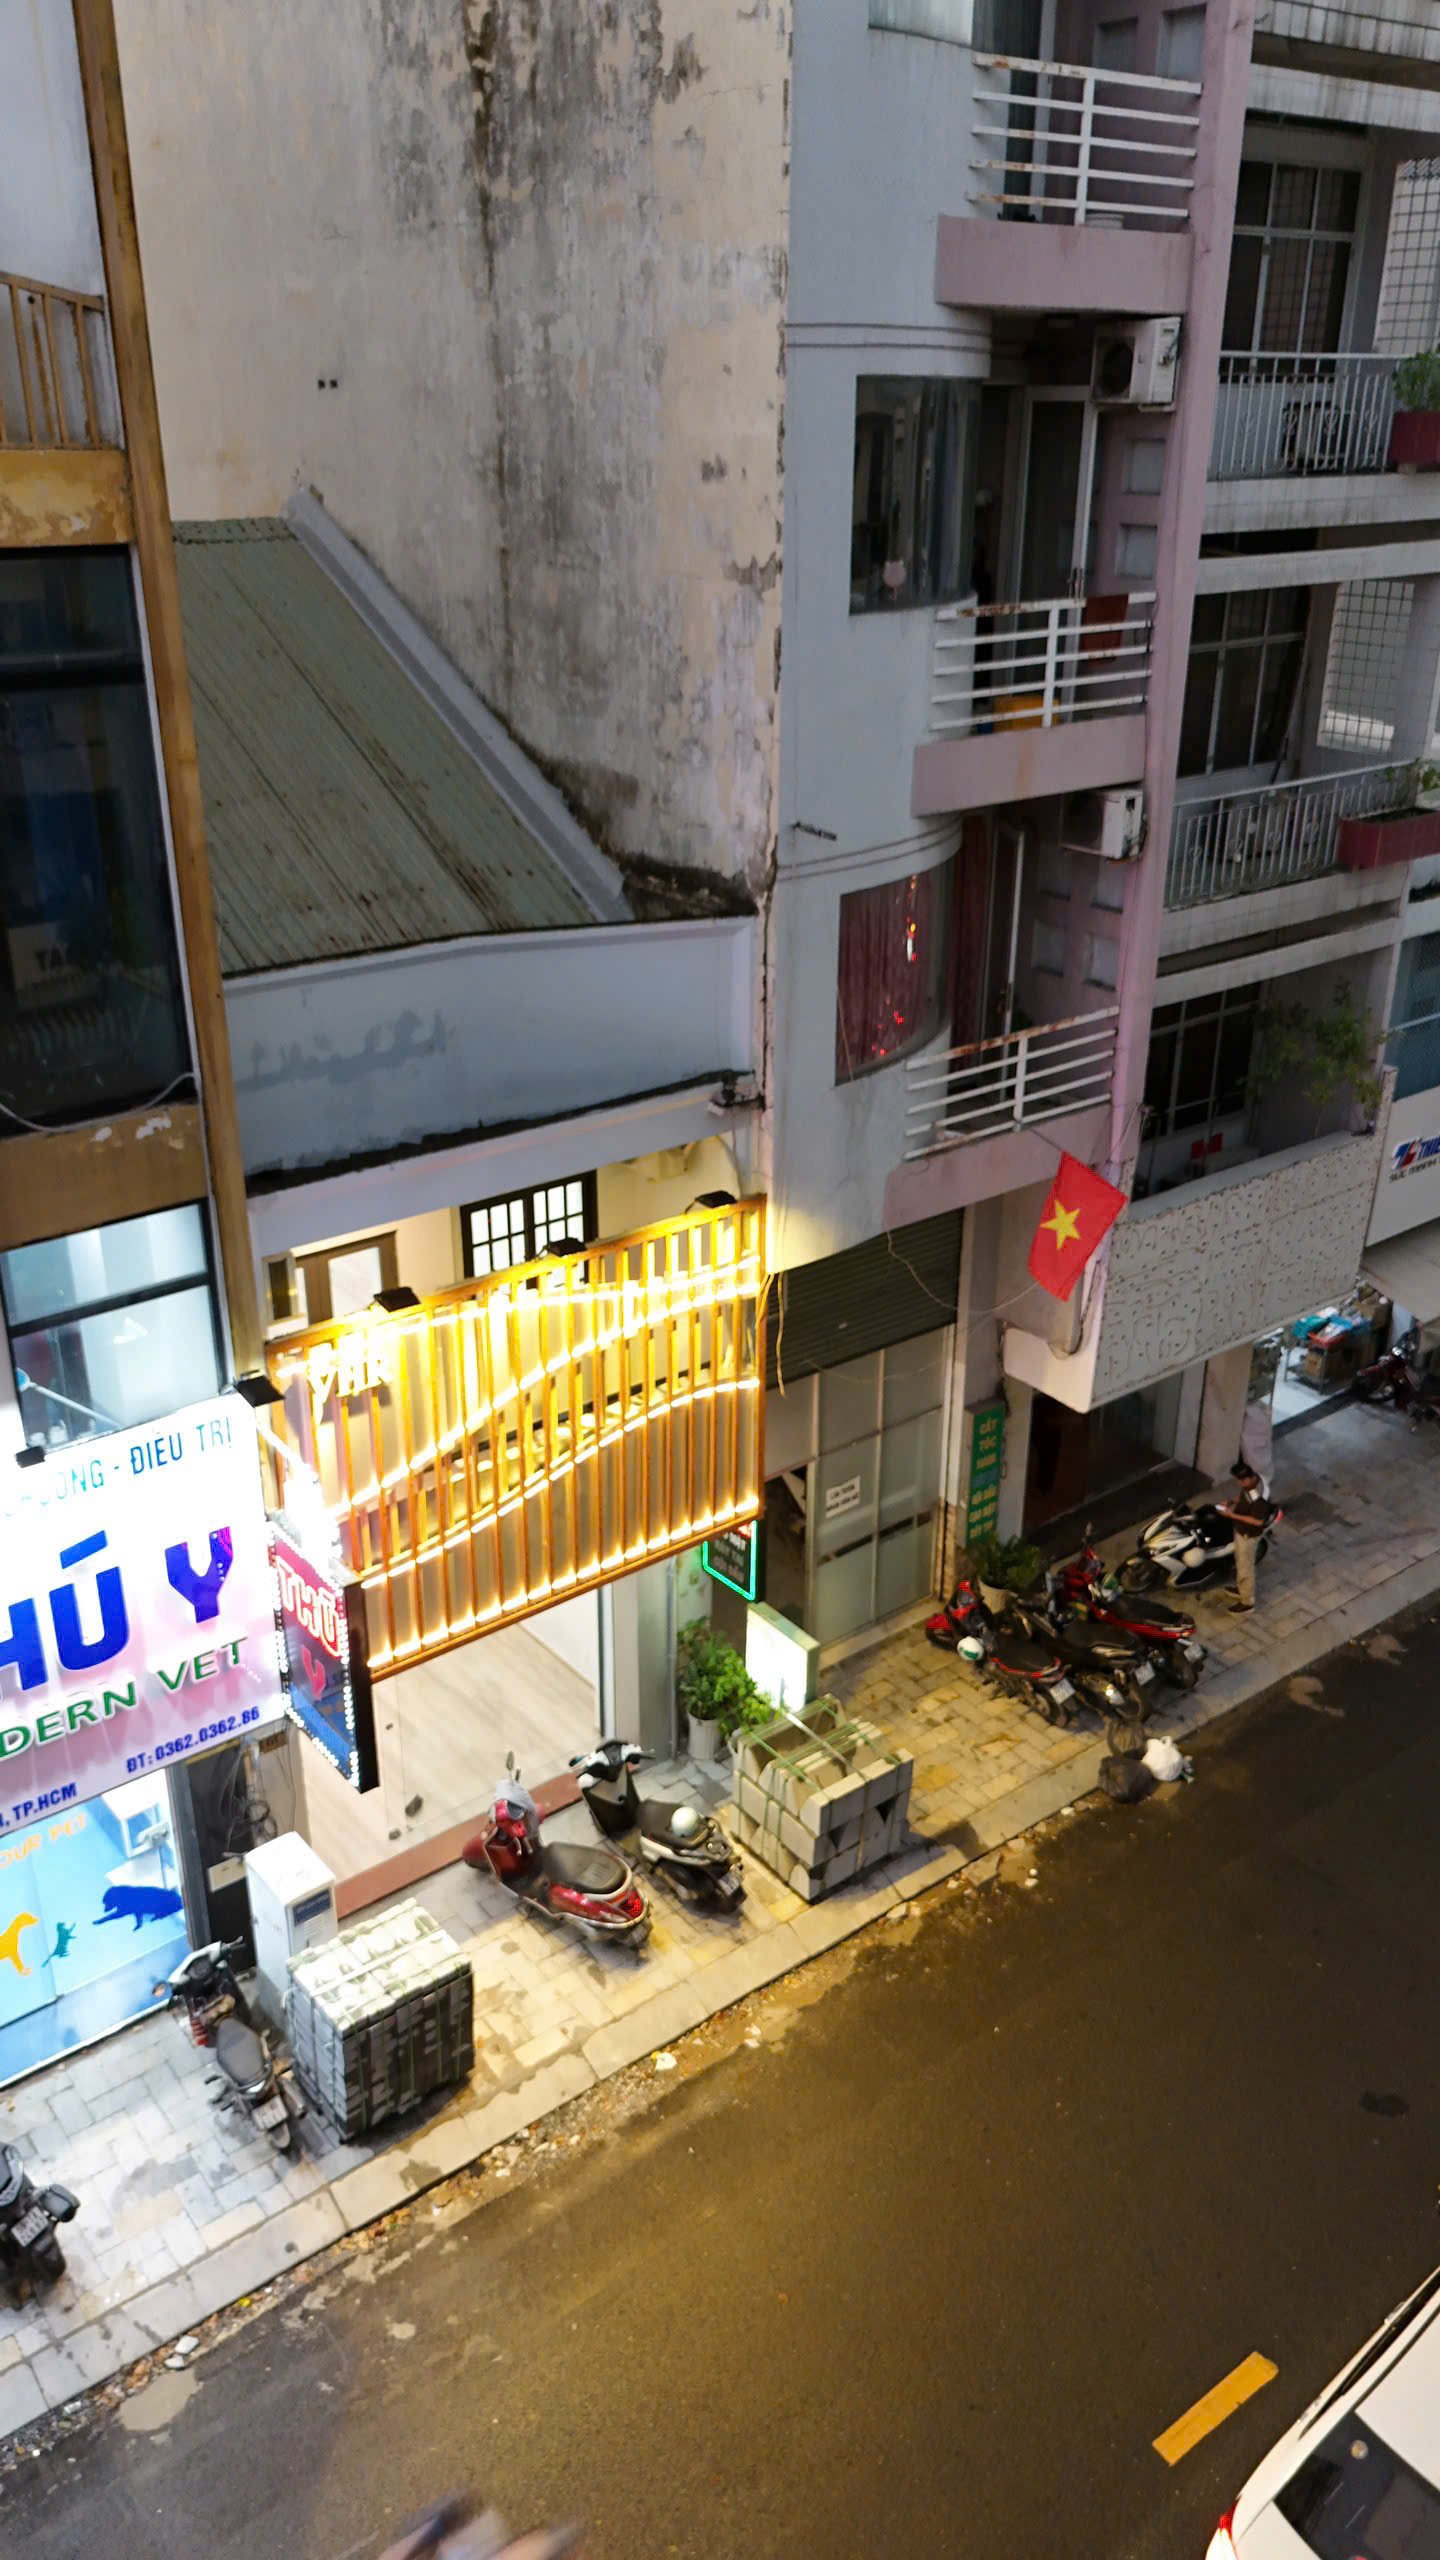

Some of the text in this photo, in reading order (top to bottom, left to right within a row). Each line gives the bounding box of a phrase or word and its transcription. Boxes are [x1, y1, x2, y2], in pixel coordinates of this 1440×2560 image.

[164, 1526, 234, 1624] Y
[157, 1636, 248, 1691] VET
[155, 1706, 260, 1761] 0362.0362.86
[12, 1782, 78, 1821] TP.HCM
